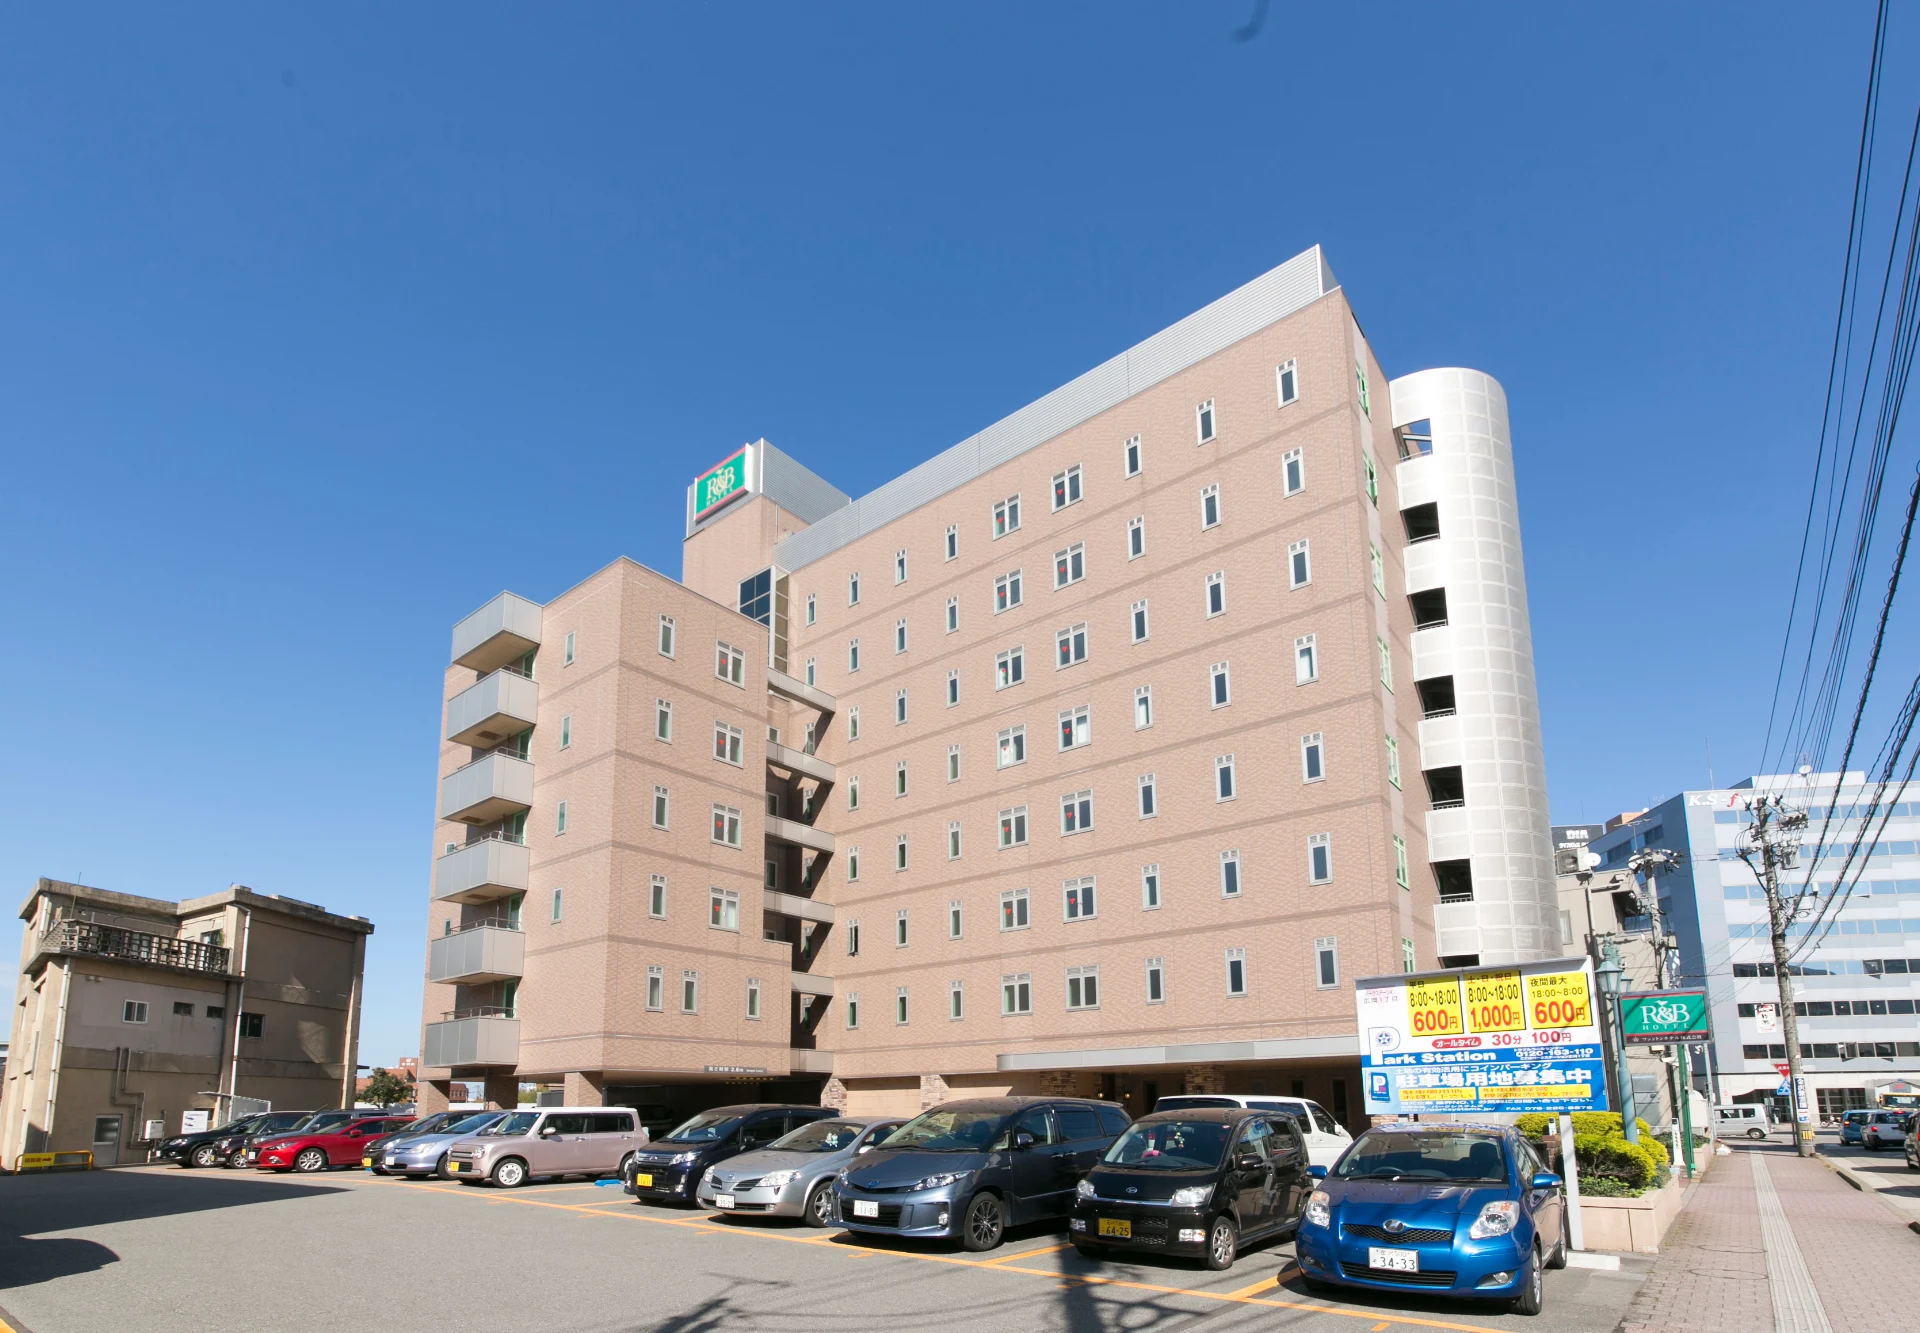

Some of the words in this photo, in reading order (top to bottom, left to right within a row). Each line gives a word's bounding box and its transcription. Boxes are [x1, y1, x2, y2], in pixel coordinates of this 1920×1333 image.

[707, 467, 735, 499] R&B
[1409, 980, 1425, 989] 平日
[1530, 976, 1567, 988] 夜間最大
[1535, 1000, 1586, 1024] 600円
[1641, 1003, 1690, 1025] R&B
[1413, 1009, 1458, 1032] 600円
[1642, 1022, 1690, 1031] HOTEL
[1436, 1038, 1479, 1048] オールタイム
[1421, 1051, 1497, 1063] Station
[1395, 1068, 1592, 1089] 駐車場用地募集中
[1106, 1225, 1130, 1237] 64-25
[1380, 1256, 1416, 1271] 34-33
